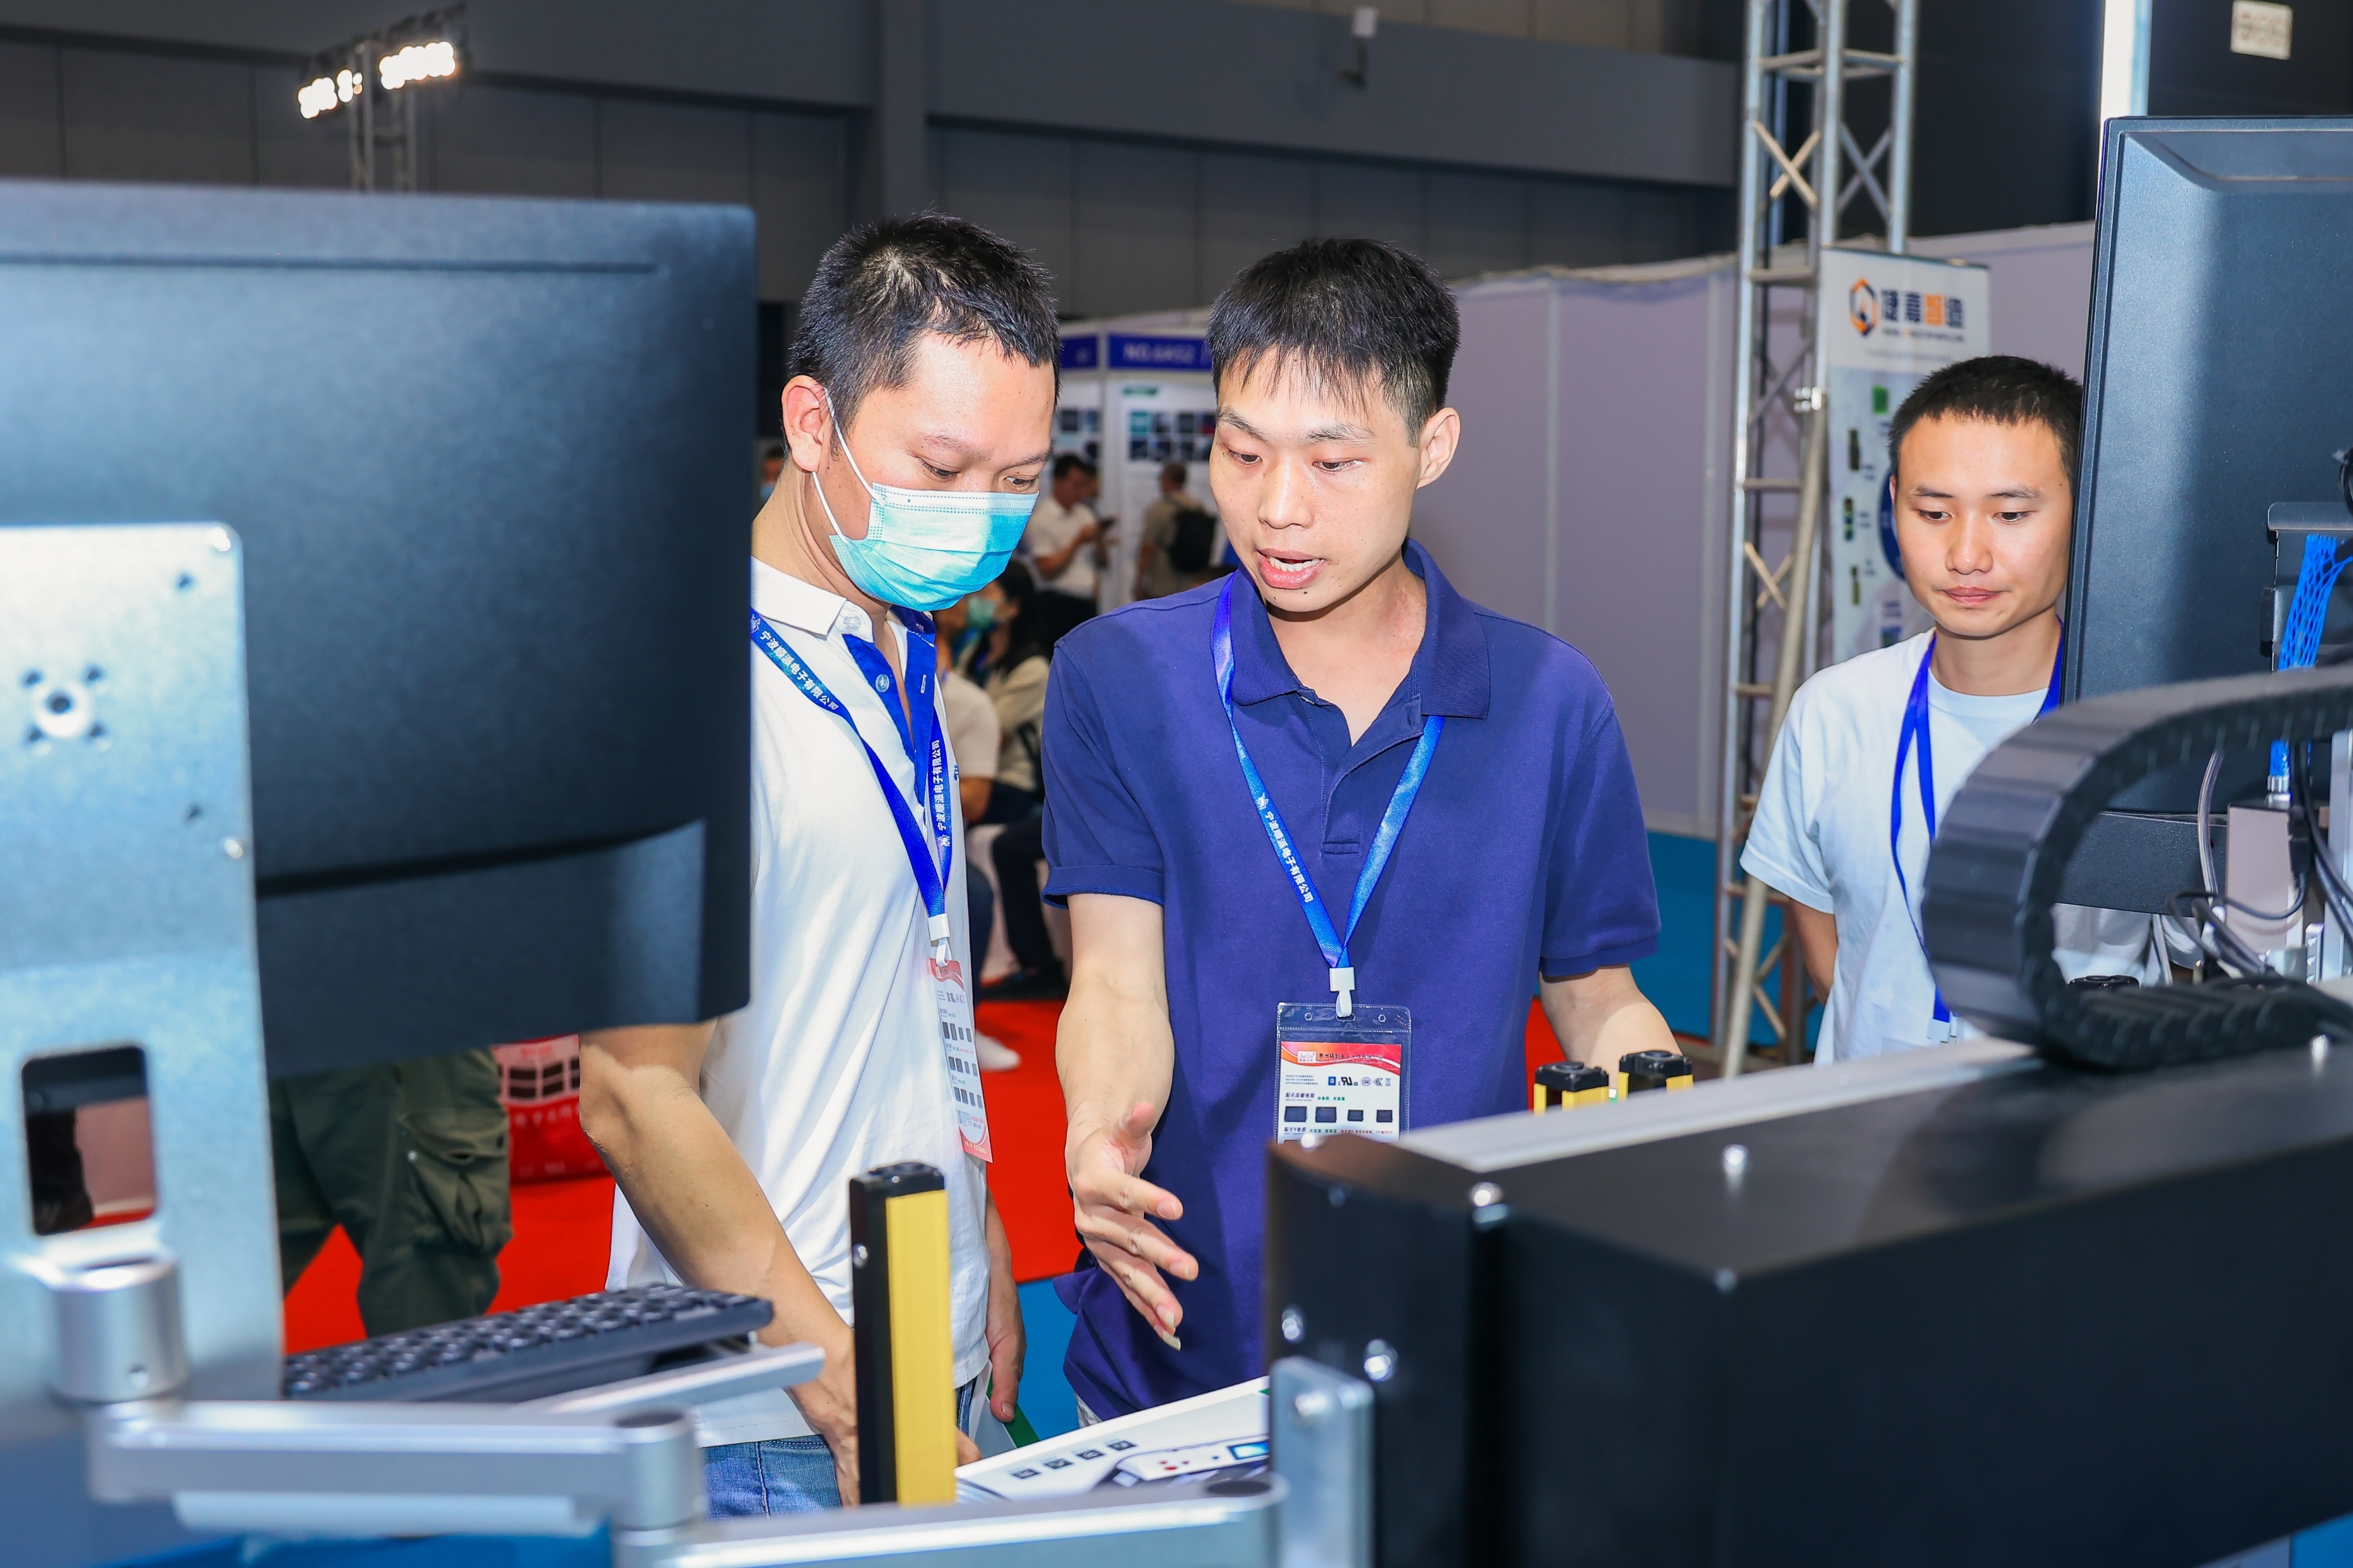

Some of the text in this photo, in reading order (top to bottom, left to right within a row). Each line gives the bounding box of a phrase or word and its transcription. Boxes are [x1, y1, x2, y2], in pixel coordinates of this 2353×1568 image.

[760, 631, 839, 709] 宁波顺派电子有限公司
[932, 740, 947, 831] 宁波顺派电子有限公司
[1265, 811, 1314, 902] 宁波顺派电子有限公司
